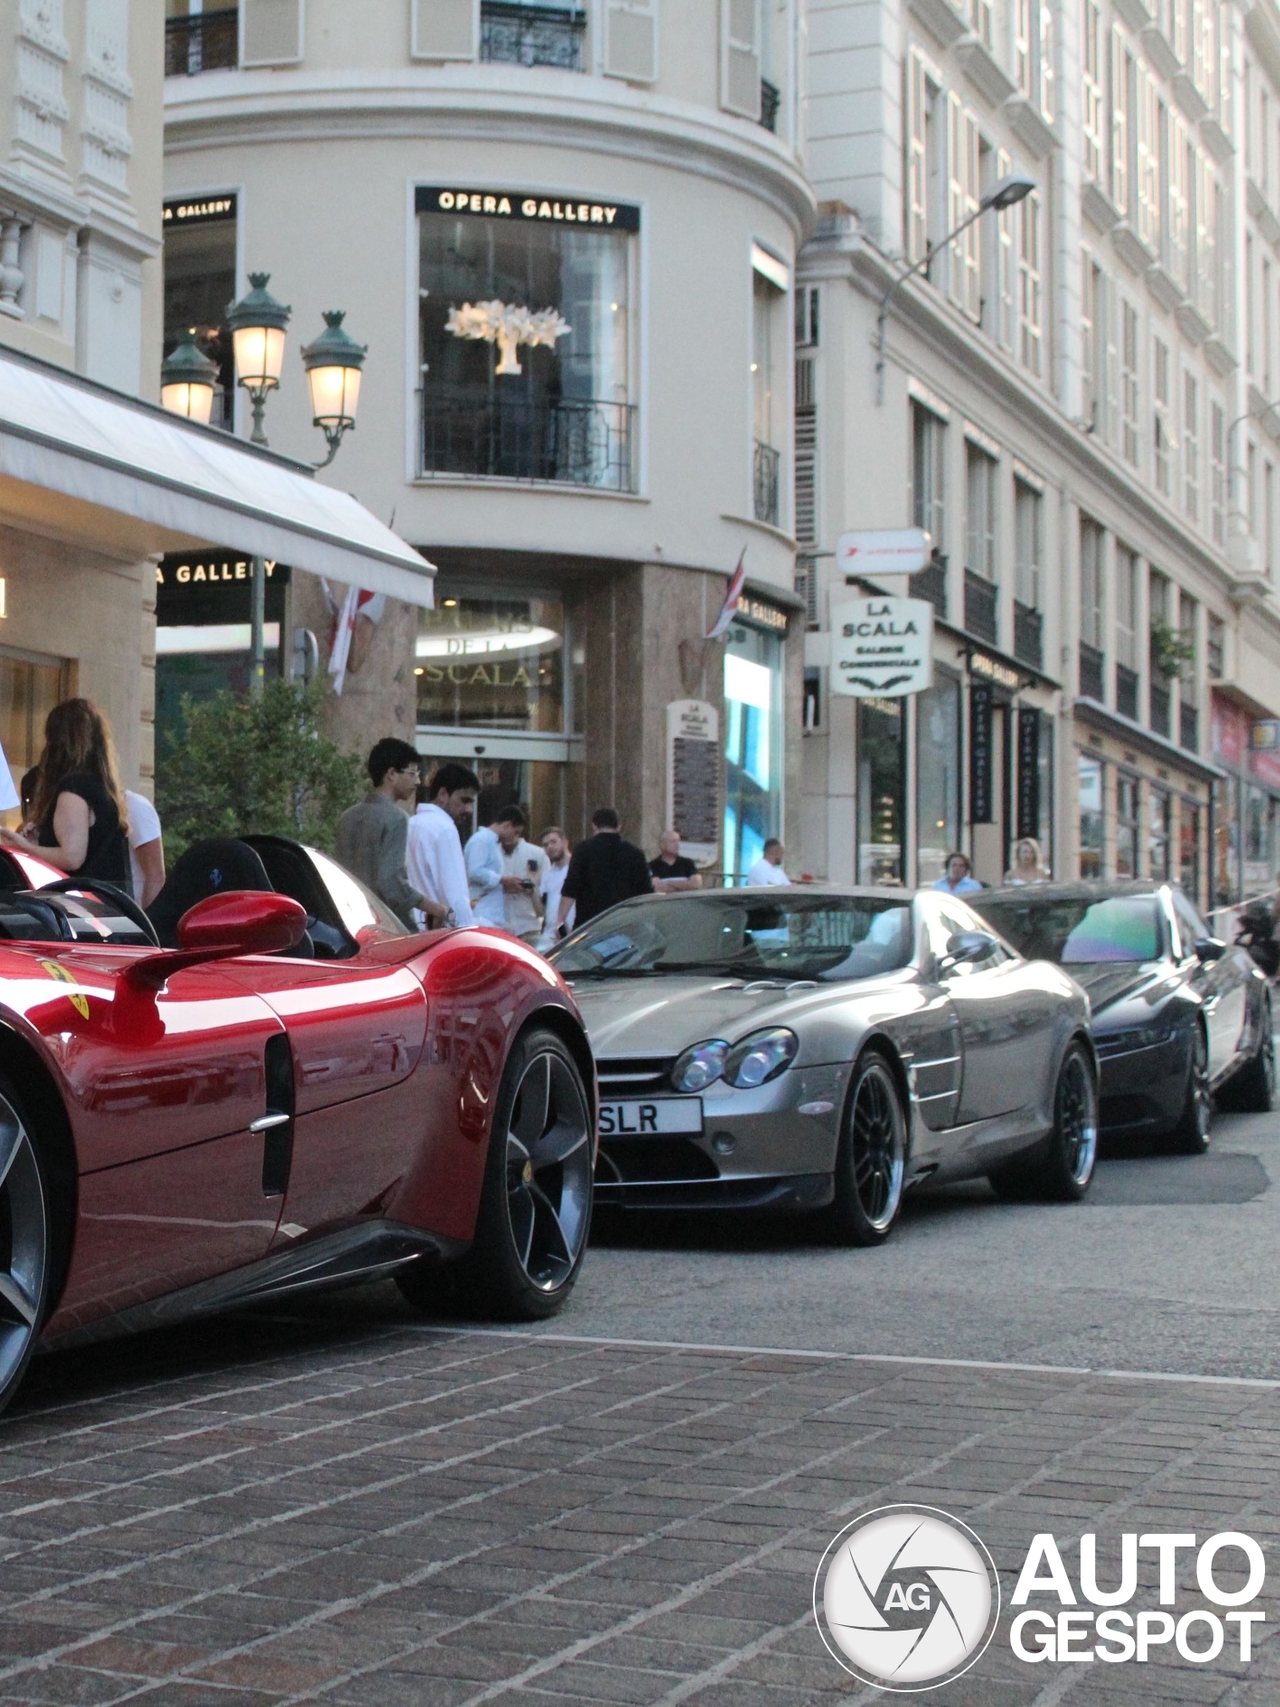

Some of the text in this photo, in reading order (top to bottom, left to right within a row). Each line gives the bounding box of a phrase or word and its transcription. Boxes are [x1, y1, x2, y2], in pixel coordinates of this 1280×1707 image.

[177, 200, 232, 219] GALLERY
[438, 192, 617, 223] OPERA GALLERY
[176, 561, 276, 583] GALLEY
[867, 603, 892, 616] LA
[842, 621, 918, 638] SCALA
[425, 663, 532, 687] SCALA
[598, 1104, 658, 1133] SLR
